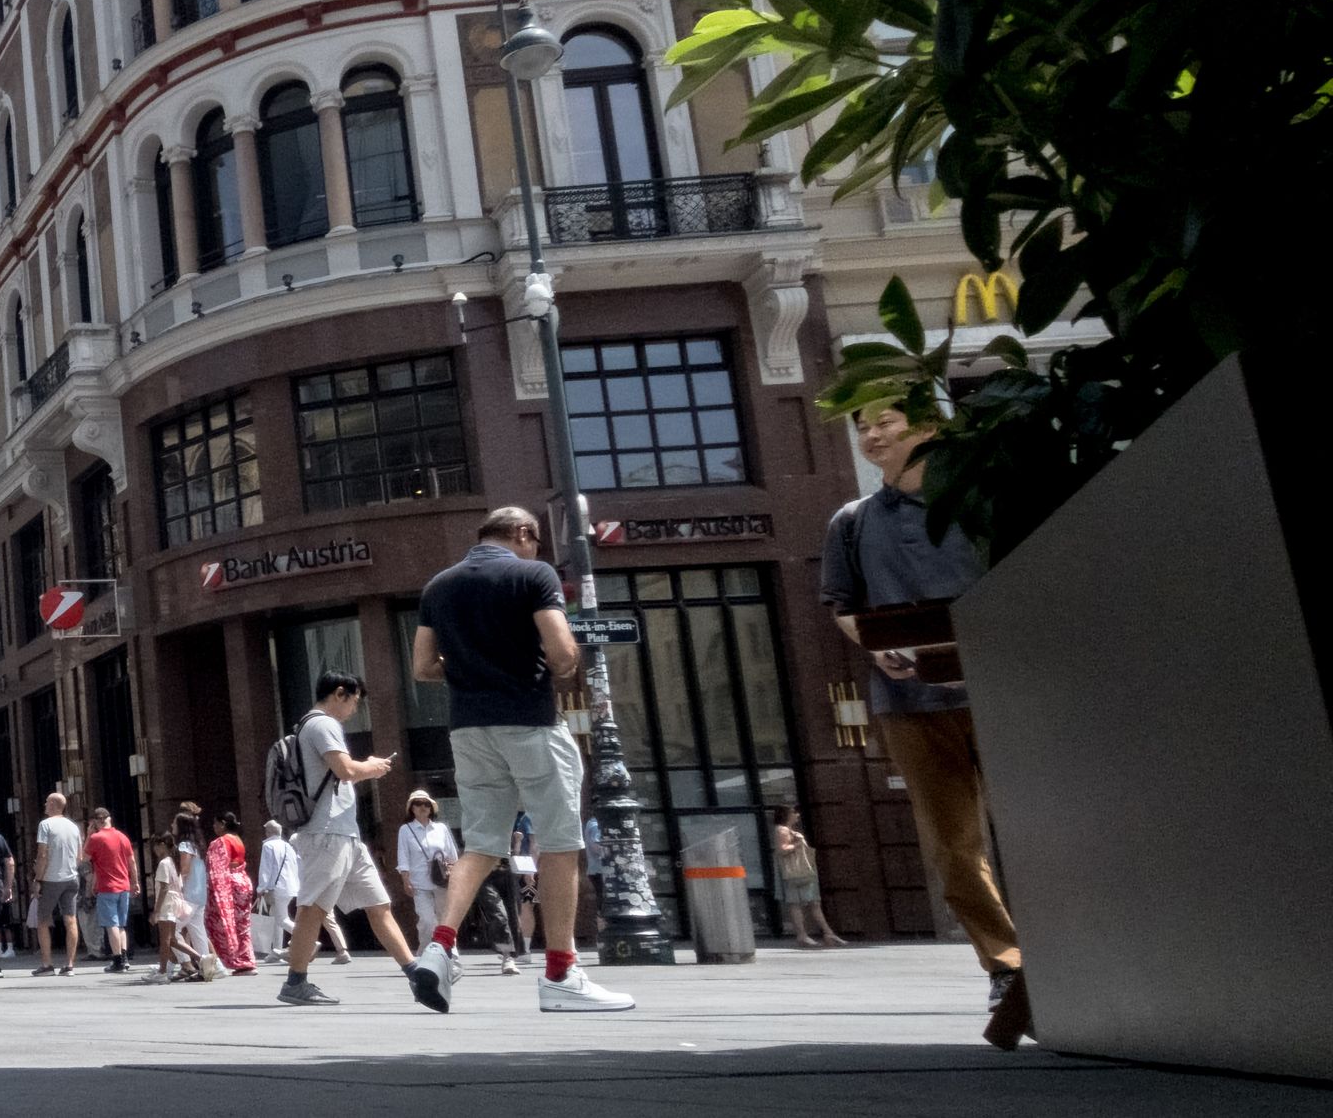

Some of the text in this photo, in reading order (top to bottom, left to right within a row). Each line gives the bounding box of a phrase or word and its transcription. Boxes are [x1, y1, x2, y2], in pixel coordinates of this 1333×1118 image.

[625, 514, 768, 540] Bank Austria
[223, 537, 371, 582] Bank Austria
[586, 633, 610, 643] Platz
